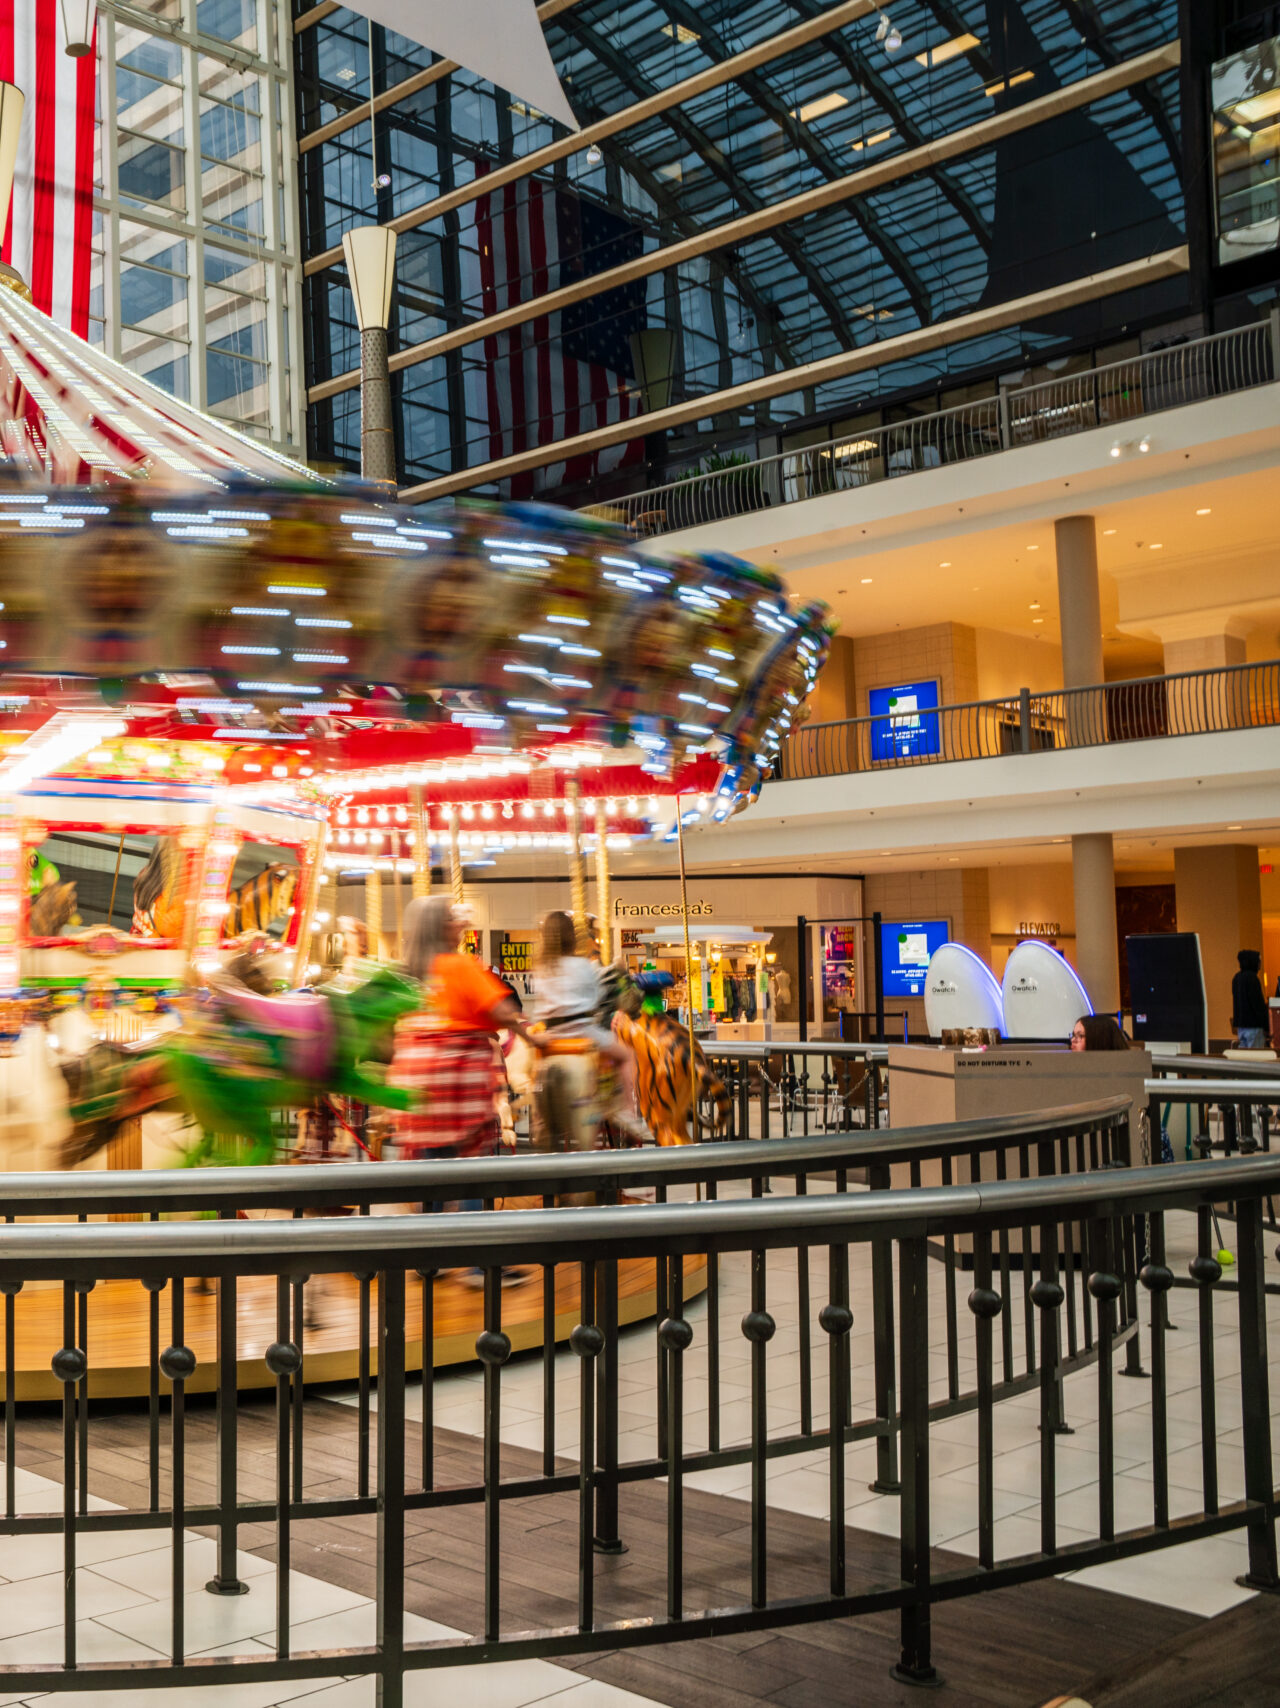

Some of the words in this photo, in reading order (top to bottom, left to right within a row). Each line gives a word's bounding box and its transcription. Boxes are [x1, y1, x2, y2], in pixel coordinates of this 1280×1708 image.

[614, 898, 713, 917] francesca's
[1019, 922, 1061, 937] ELEVATOR
[503, 956, 533, 971] STOR
